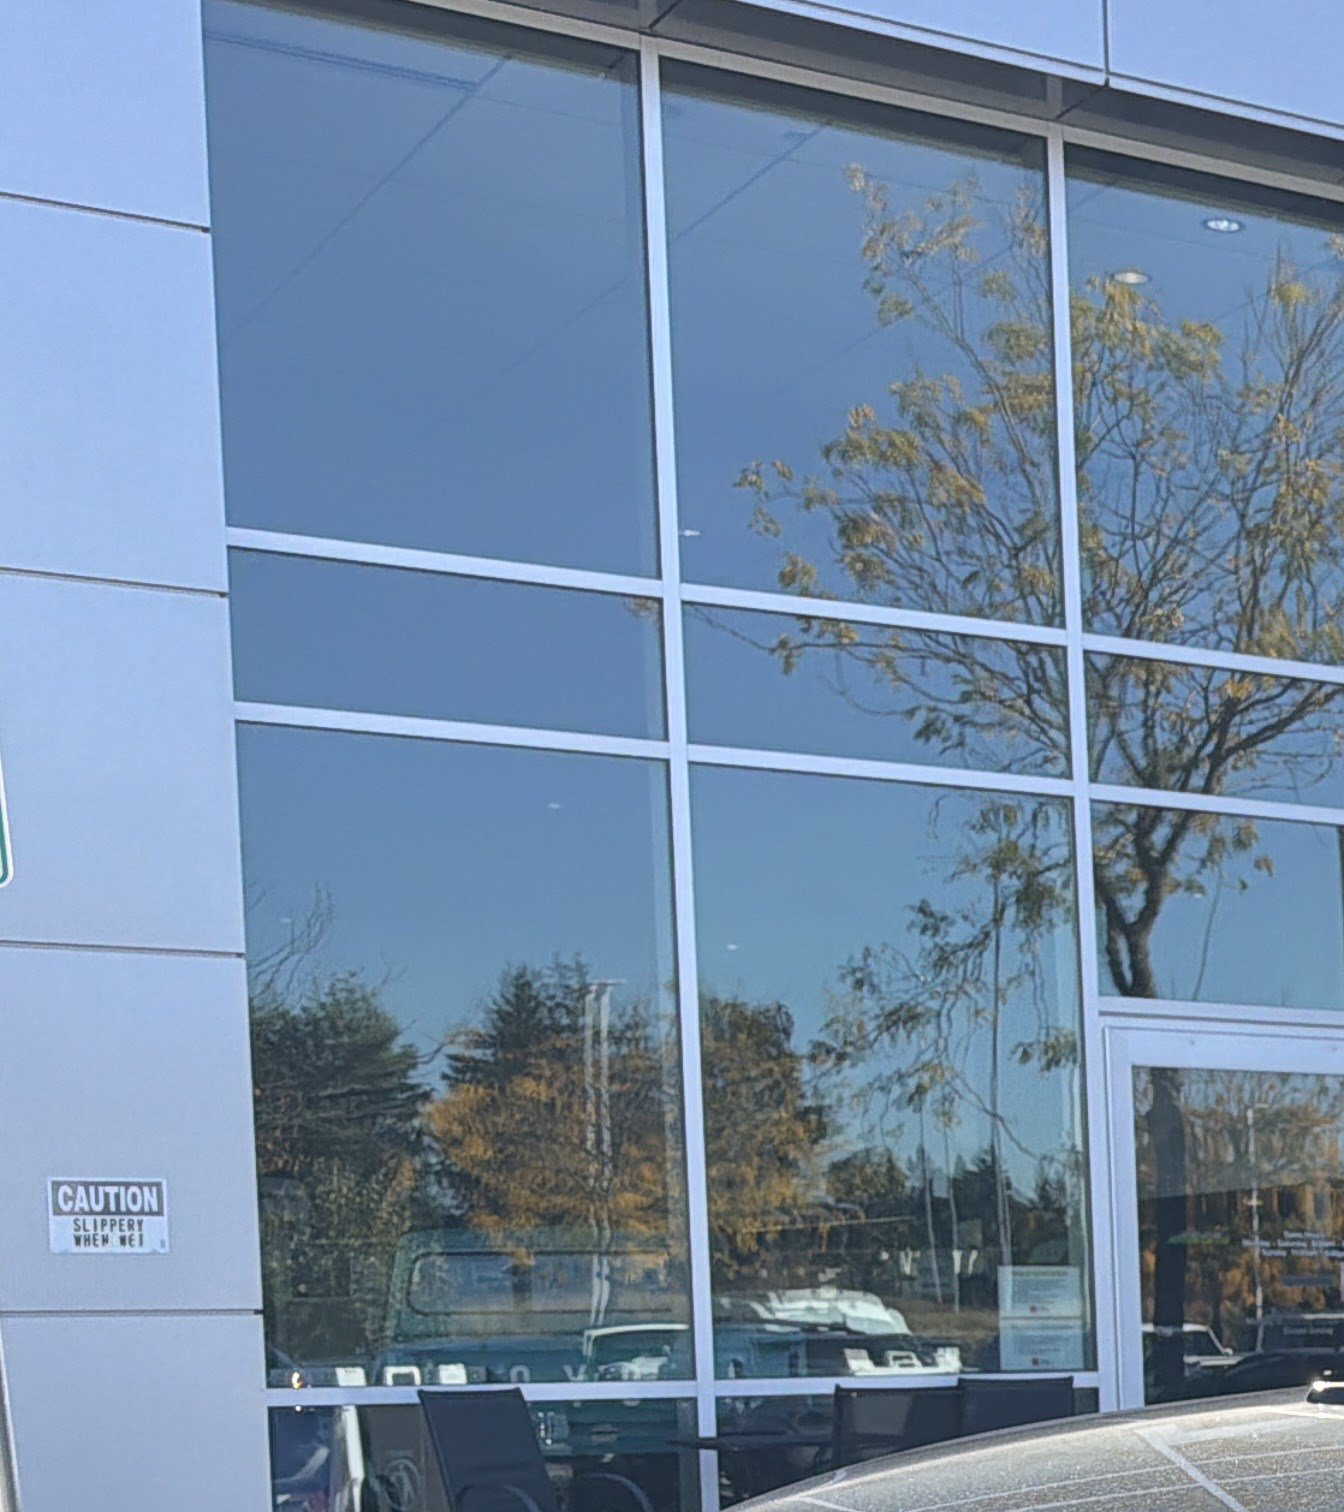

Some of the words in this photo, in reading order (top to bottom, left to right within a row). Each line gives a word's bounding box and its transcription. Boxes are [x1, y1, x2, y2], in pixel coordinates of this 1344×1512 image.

[57, 1184, 159, 1213] CAUTION
[72, 1217, 144, 1233] SLIPPERY
[73, 1233, 110, 1248] WHEN
[118, 1232, 144, 1248] WET
